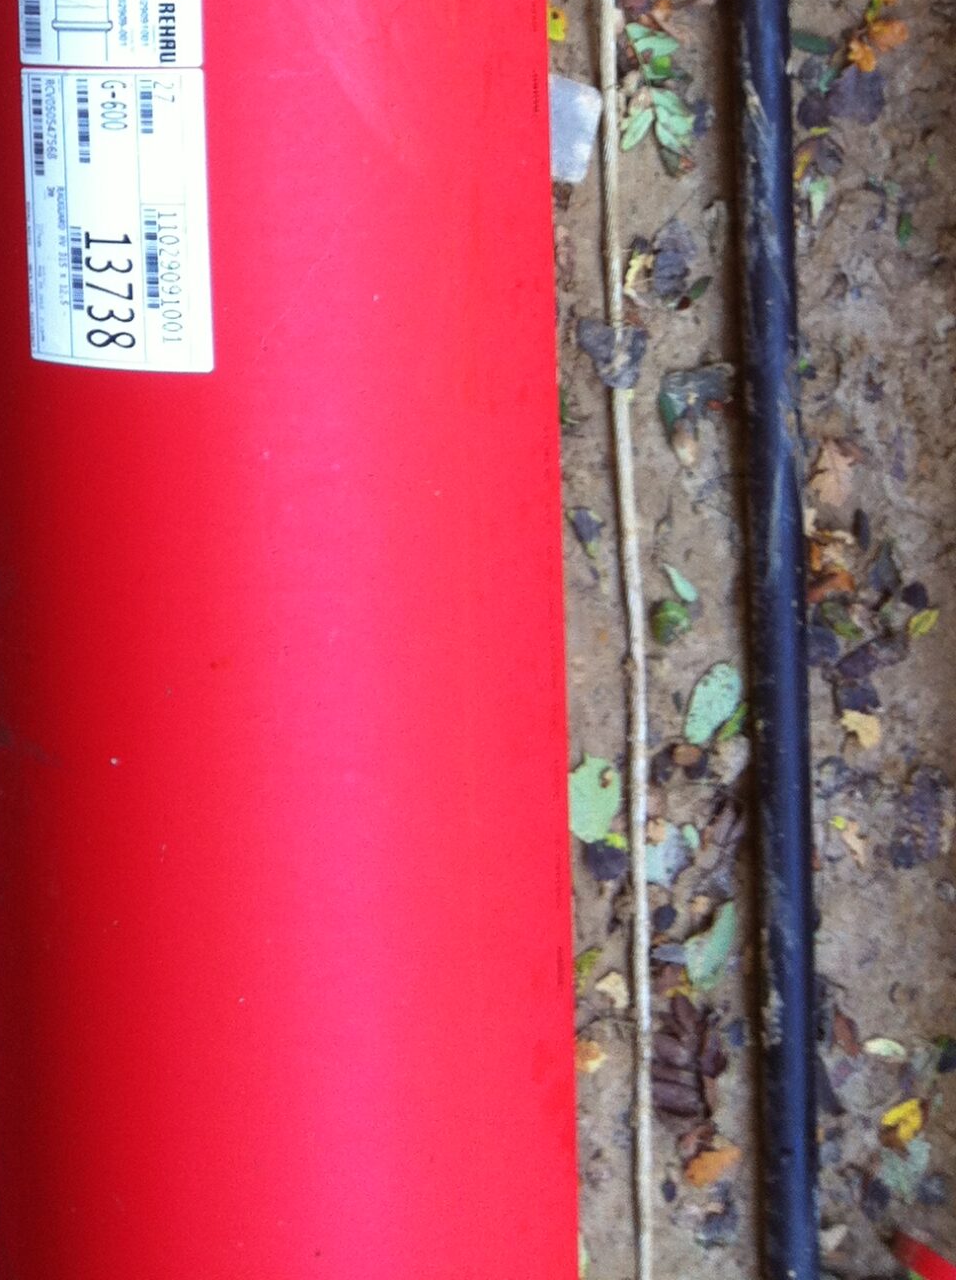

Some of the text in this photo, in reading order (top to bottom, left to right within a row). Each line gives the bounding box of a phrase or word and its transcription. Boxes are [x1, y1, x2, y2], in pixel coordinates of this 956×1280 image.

[158, 2, 176, 64] REHAU
[101, 80, 128, 131] G-600
[154, 81, 176, 103] 27
[85, 231, 136, 349] 13738
[158, 211, 183, 344] 11029091001
